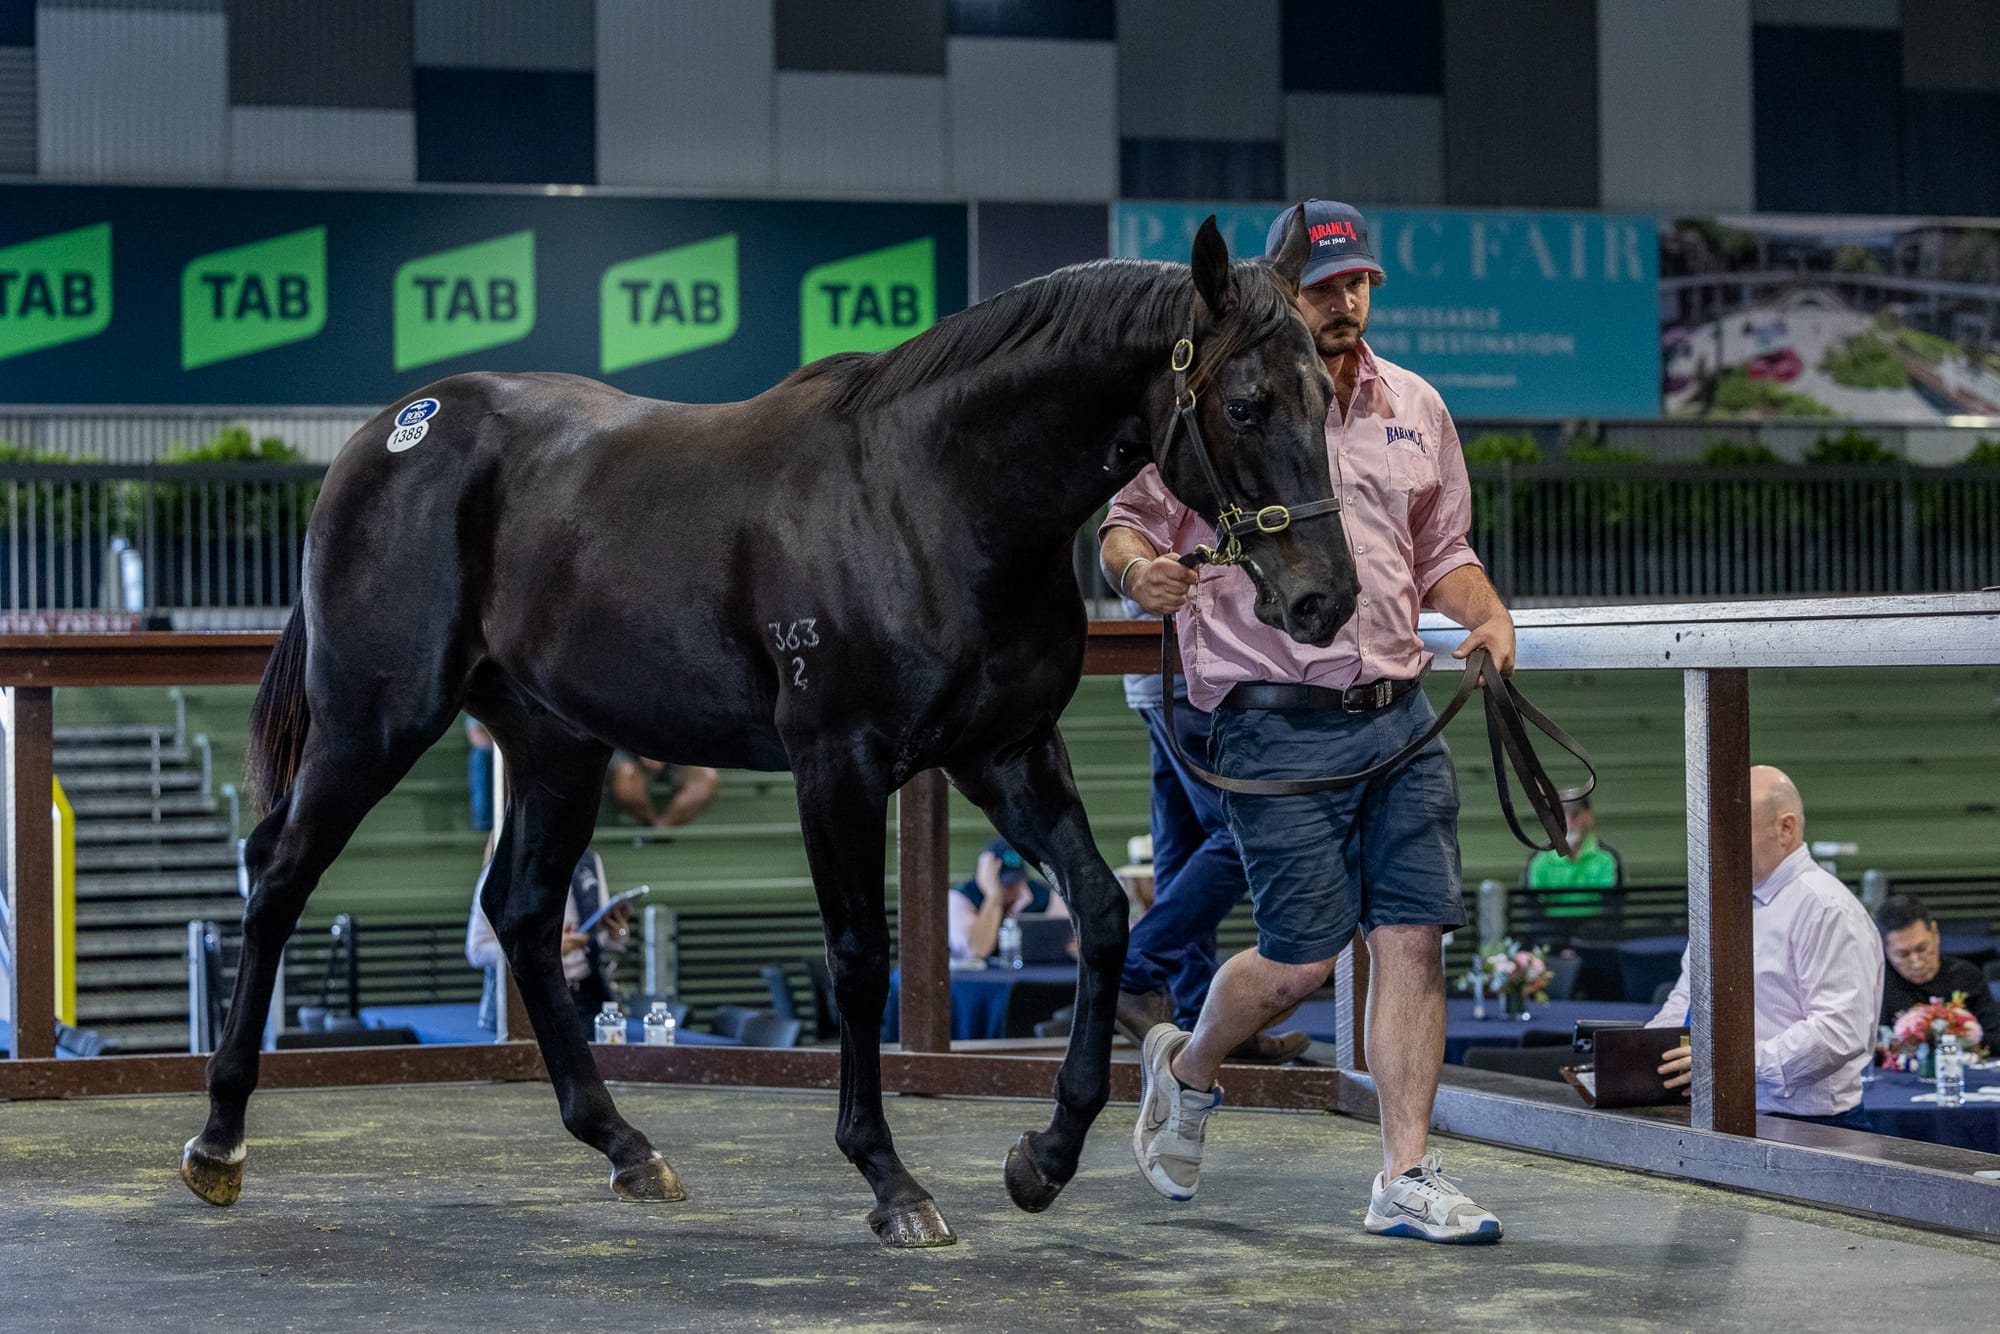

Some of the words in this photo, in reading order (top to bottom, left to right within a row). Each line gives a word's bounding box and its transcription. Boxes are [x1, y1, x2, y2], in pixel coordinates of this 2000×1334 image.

[1308, 221, 1357, 243] ARAMUL
[1319, 239, 1331, 247] Est
[1331, 237, 1346, 245] 1940
[1468, 216, 1645, 284] FAIR
[0, 271, 97, 318] TAB
[203, 273, 310, 321] TAB
[414, 275, 518, 323] TAB
[619, 279, 723, 326] TAB
[821, 283, 921, 328] TAB
[393, 425, 424, 445] 1388
[768, 618, 820, 652] 363
